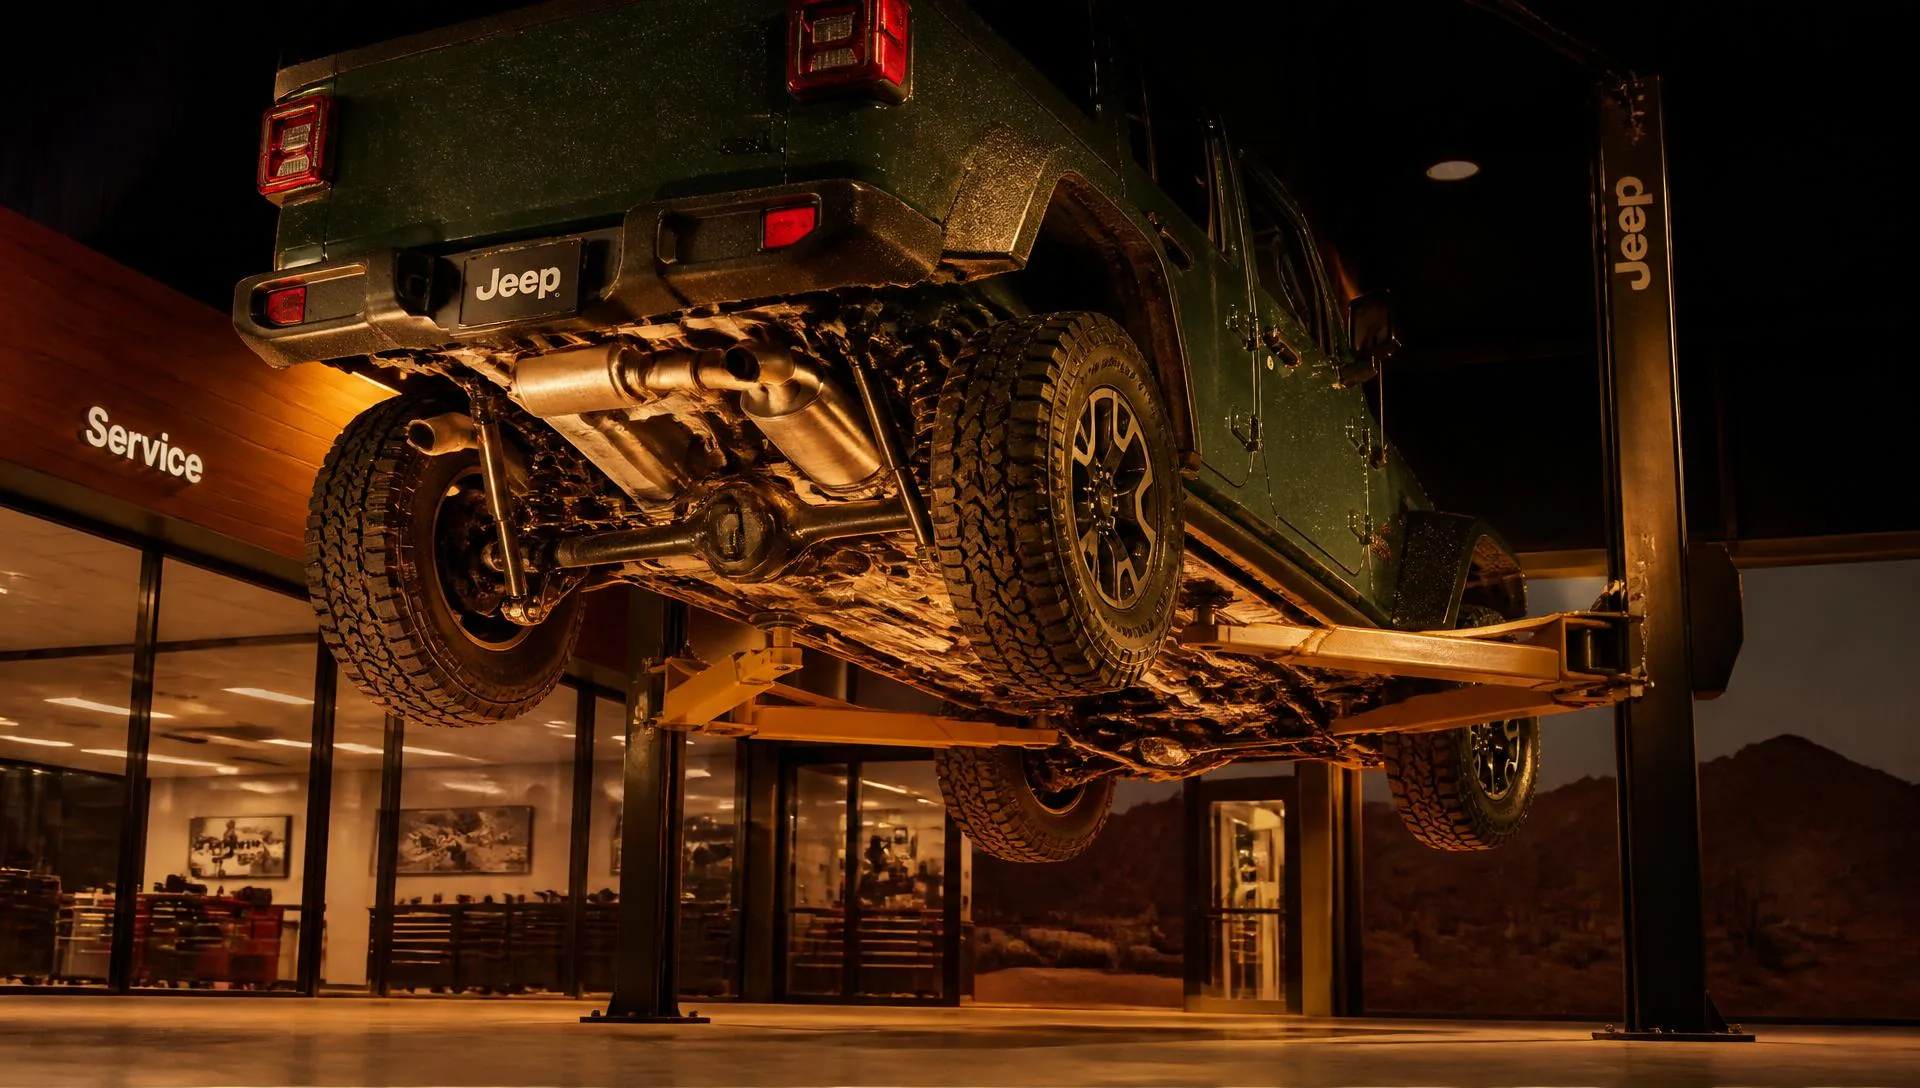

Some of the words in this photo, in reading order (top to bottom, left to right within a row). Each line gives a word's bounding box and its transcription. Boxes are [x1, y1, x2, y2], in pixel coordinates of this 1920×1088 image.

[1615, 175, 1653, 291] Jeep
[475, 267, 561, 301] Jeep
[86, 406, 203, 484] Service
